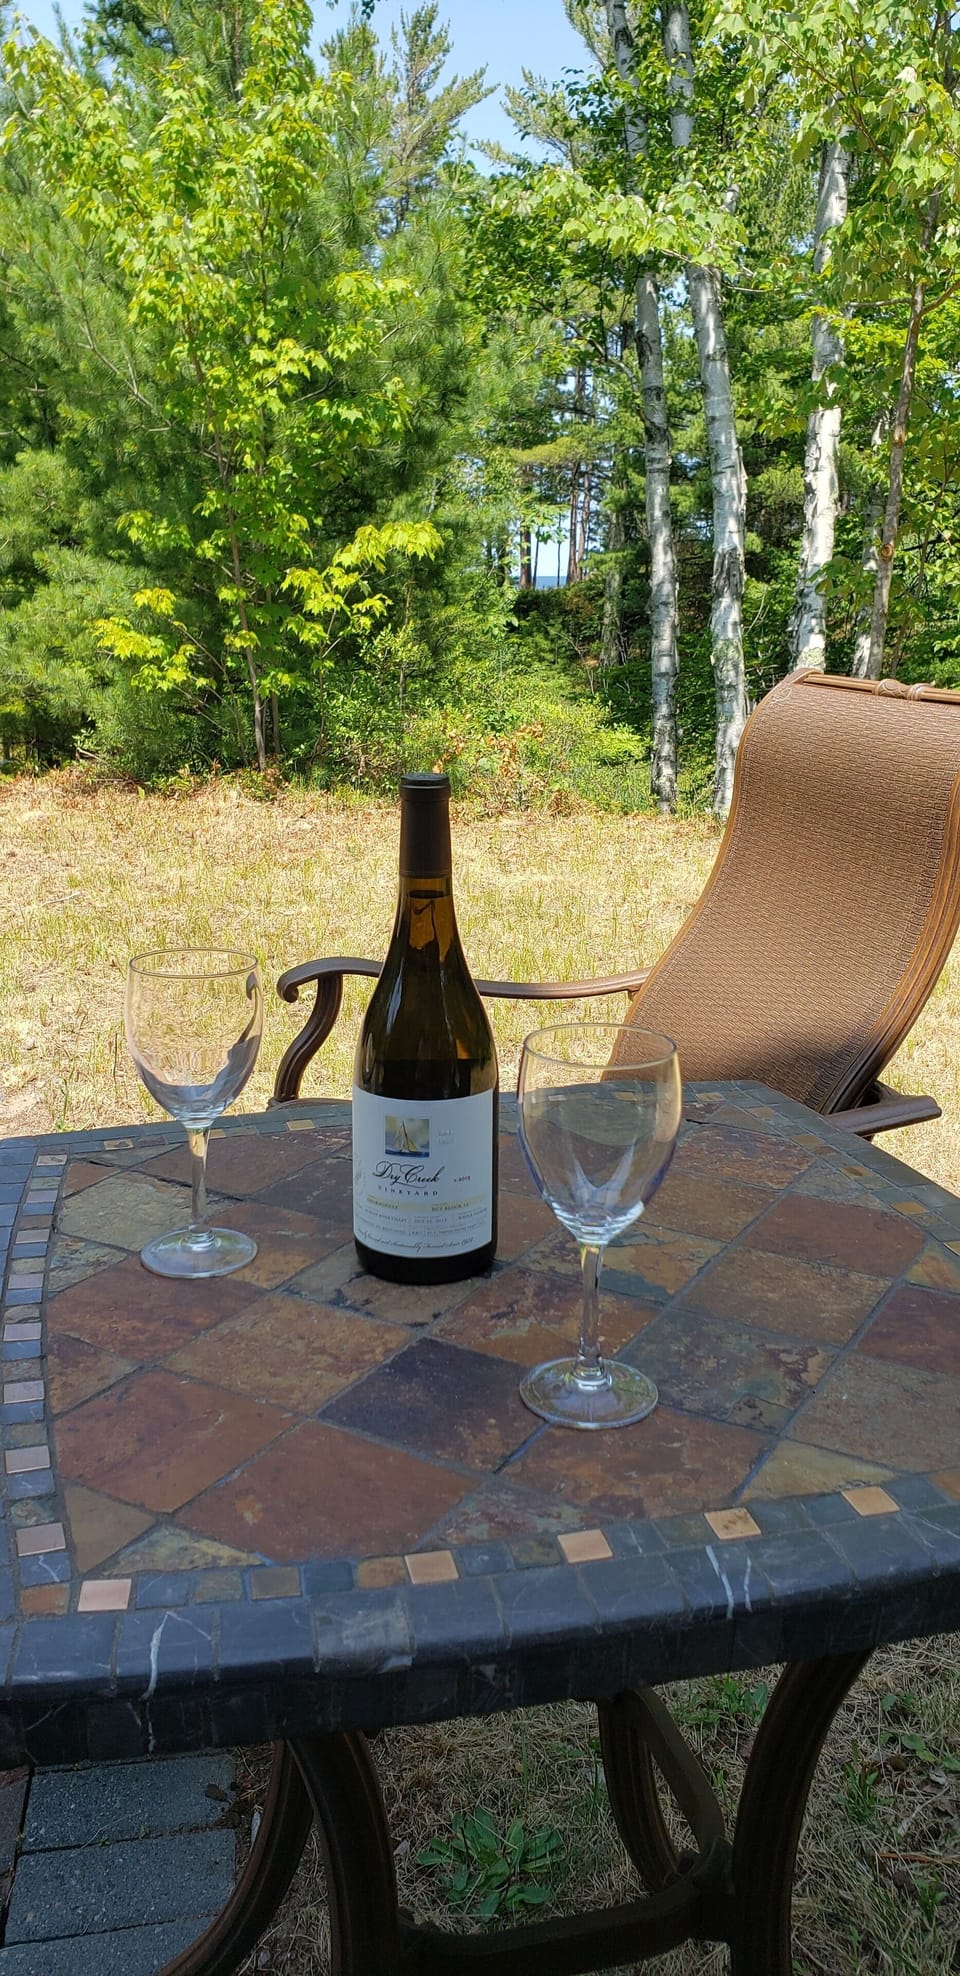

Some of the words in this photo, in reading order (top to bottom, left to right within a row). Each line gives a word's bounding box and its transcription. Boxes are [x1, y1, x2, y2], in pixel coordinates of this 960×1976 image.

[372, 1161, 401, 1186] Dry
[400, 1164, 446, 1184] Creek
[378, 1185, 438, 1196] VINEYARD
